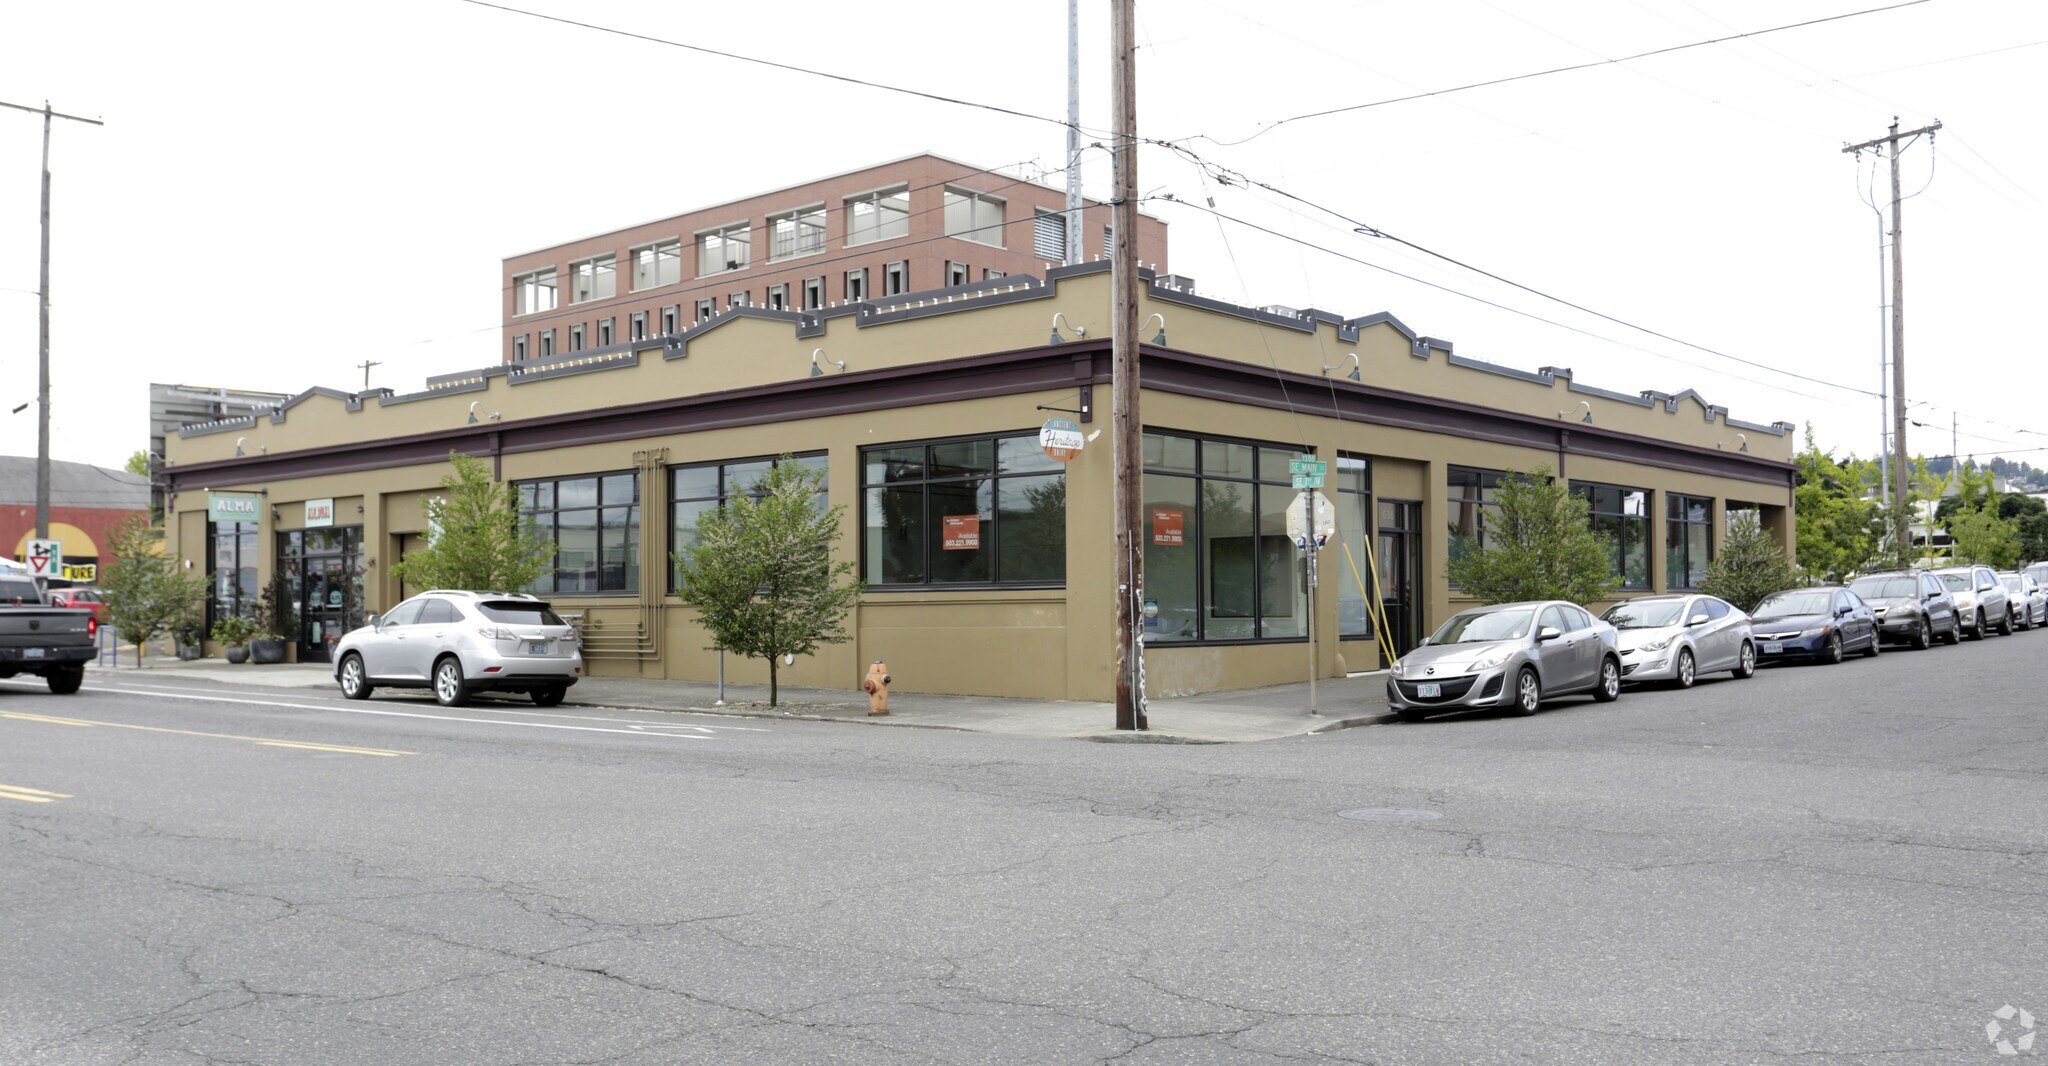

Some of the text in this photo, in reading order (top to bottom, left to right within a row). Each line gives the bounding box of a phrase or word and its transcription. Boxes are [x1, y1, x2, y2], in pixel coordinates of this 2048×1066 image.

[1045, 429, 1081, 460] Heritage
[1290, 462, 1299, 472] SE
[1301, 463, 1317, 472] MAIN
[1295, 478, 1303, 487] SE
[1314, 477, 1321, 486] AV
[217, 500, 255, 513] ALMA
[307, 505, 330, 520] ALMA
